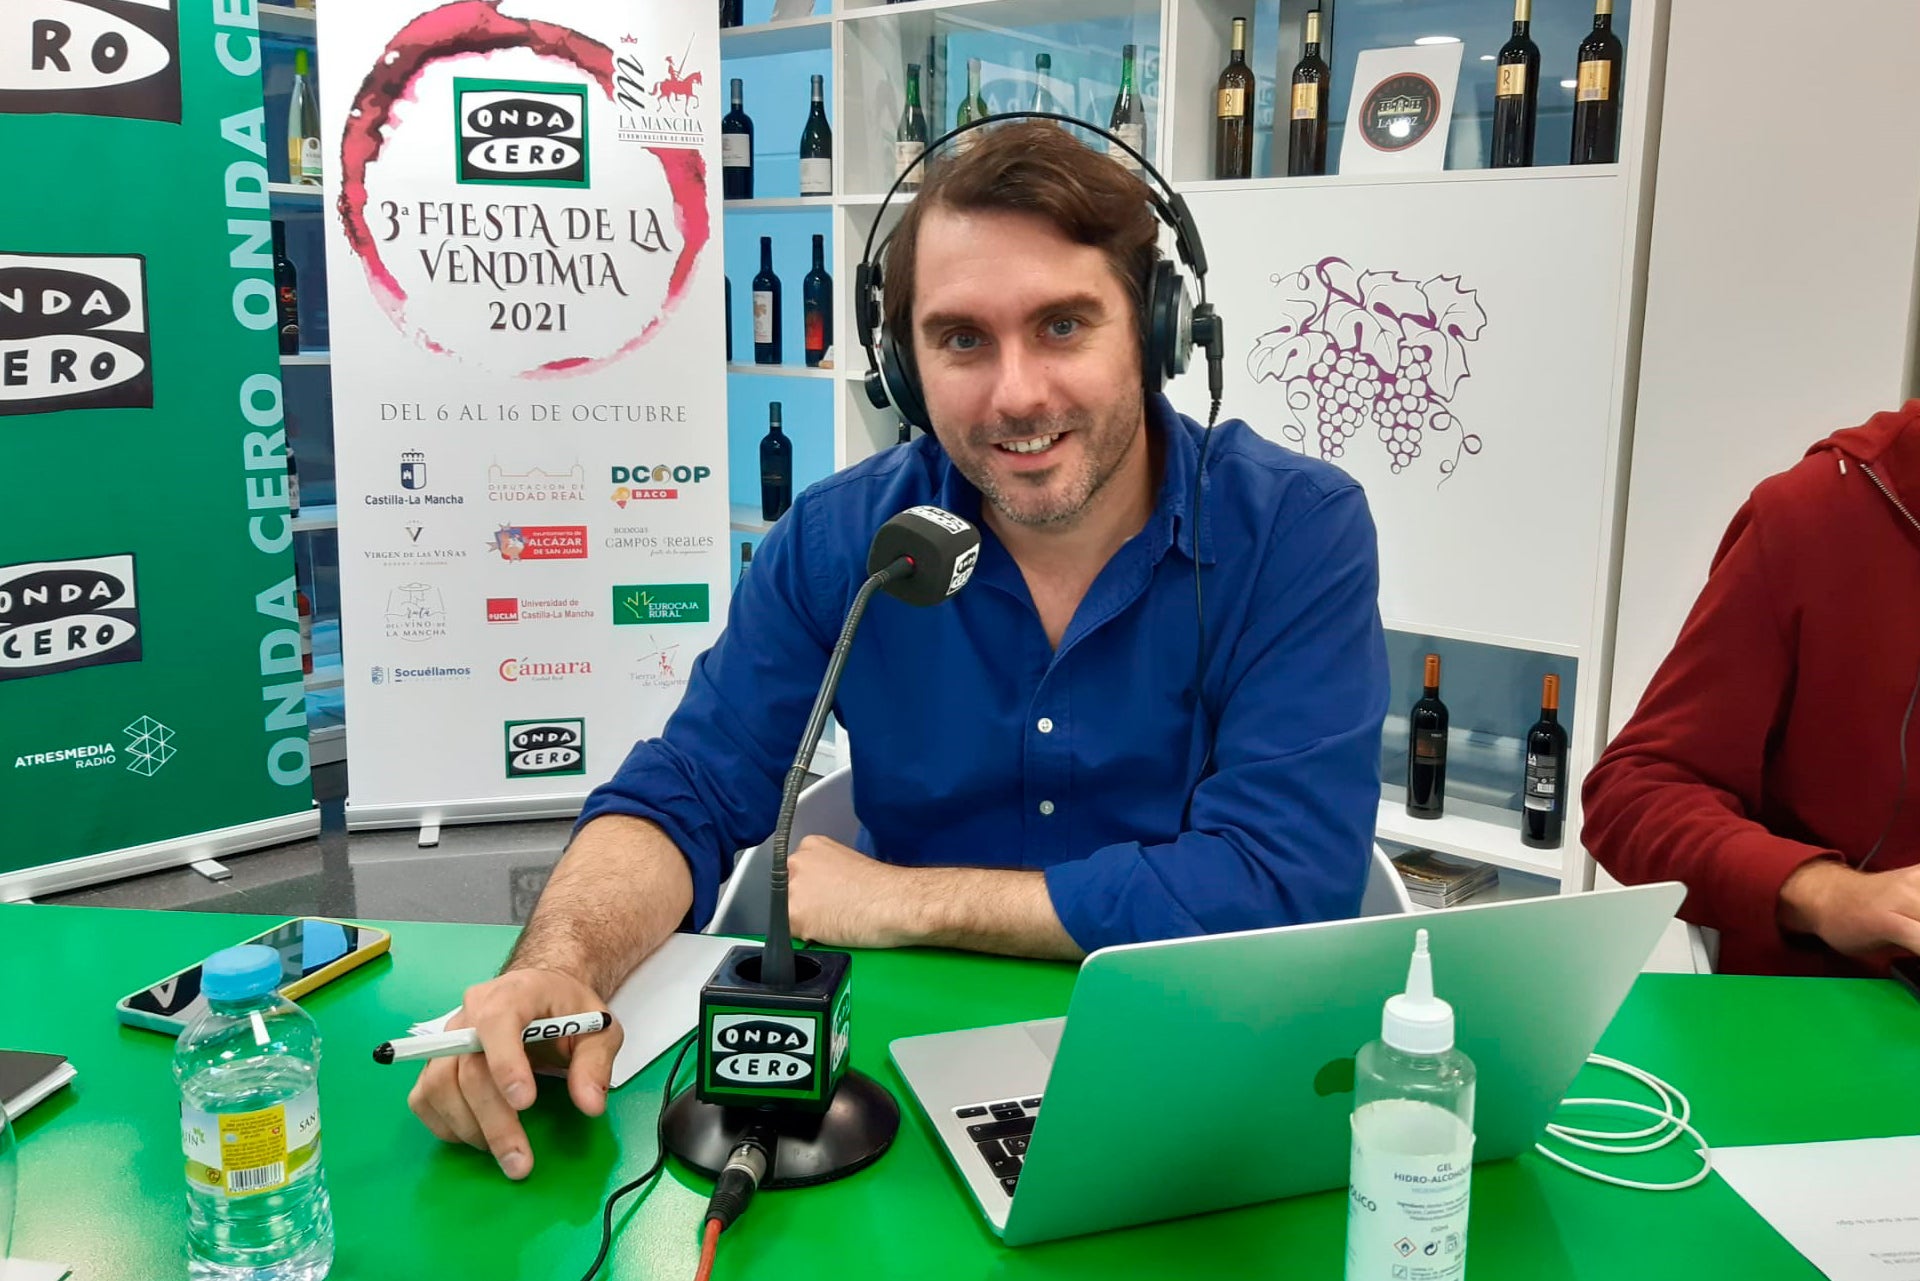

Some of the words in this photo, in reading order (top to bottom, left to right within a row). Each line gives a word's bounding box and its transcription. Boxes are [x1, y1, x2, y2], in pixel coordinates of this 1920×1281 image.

[32, 19, 129, 74] RO
[477, 108, 565, 129] ONDA
[620, 115, 636, 129] LA
[641, 116, 702, 132] MANCHA
[484, 144, 566, 166] CERO
[220, 107, 279, 331] ONDA
[419, 201, 560, 248] FIESTA
[560, 207, 615, 241] DE
[629, 207, 672, 252] LA
[419, 239, 630, 296] VENDIMIA
[488, 302, 567, 331] 2021
[4, 349, 116, 386] ERO
[380, 403, 425, 422] DEL
[436, 404, 449, 421] 6
[460, 404, 488, 422] AL
[498, 404, 520, 422] 16
[531, 405, 563, 422] DE
[572, 404, 687, 423] OCTUBRE
[240, 373, 294, 554] CERO
[364, 494, 421, 505] Castilla-La
[424, 494, 464, 504] Mancha
[488, 492, 546, 501] CIUDAD
[551, 491, 584, 501] REAL
[528, 536, 582, 547] ALCÁZAR
[521, 599, 567, 607] Universidad
[648, 602, 699, 610] EUROCAJA
[521, 610, 562, 619] Castilla-La
[564, 610, 594, 618] Mancha
[648, 610, 682, 618] RURAL
[3, 624, 115, 659] CERO
[403, 629, 446, 637] MANCHA
[394, 667, 471, 678] Socuéllamos
[499, 656, 592, 681] Cámara
[255, 575, 311, 786] ONDA
[518, 732, 571, 745] ONDA
[14, 743, 115, 768] ATRESMEDIA
[75, 755, 117, 769] RADIO
[522, 752, 571, 765] CERO
[725, 1028, 800, 1046] ONDA
[730, 1058, 799, 1076] CERO
[299, 1112, 317, 1133] SAN
[1436, 1163, 1452, 1173] GEL
